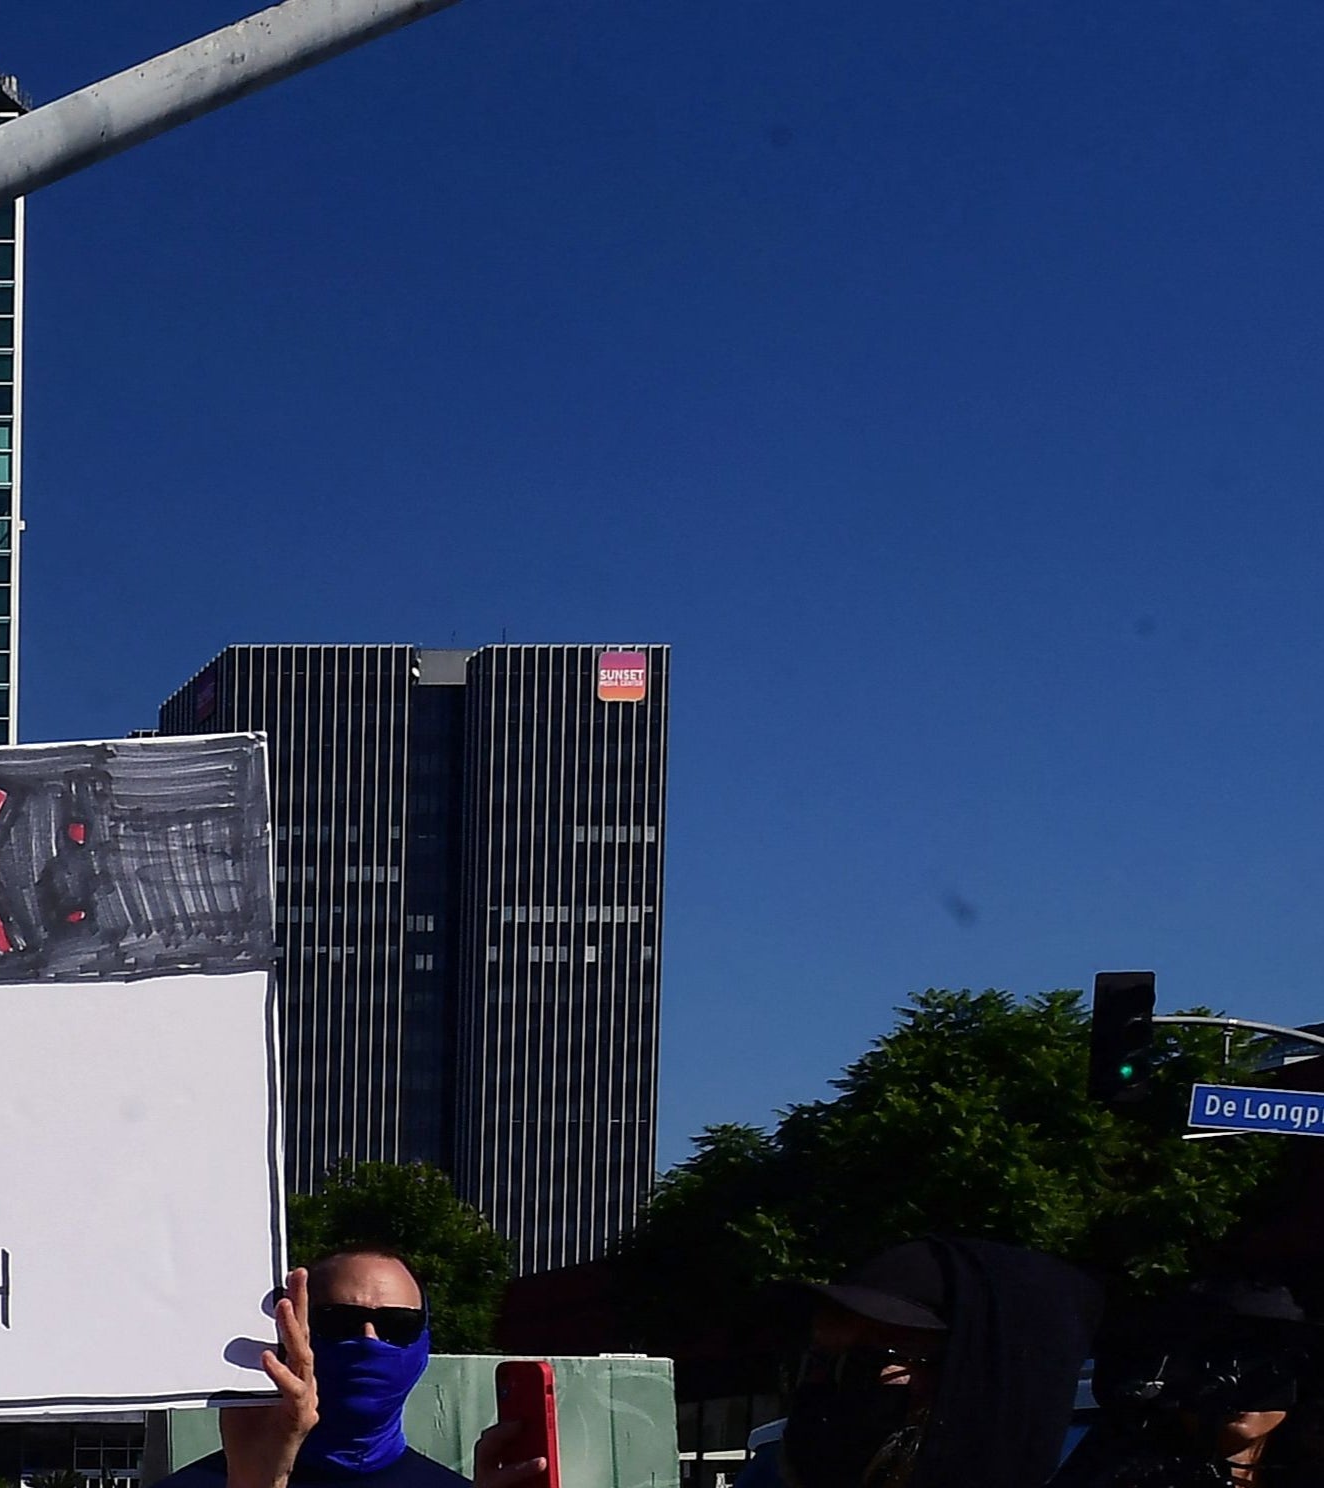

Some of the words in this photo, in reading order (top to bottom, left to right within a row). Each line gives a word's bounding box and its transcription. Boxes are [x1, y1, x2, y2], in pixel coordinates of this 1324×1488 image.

[600, 669, 644, 680] SUNSET
[1204, 1094, 1237, 1117] De
[1243, 1097, 1324, 1129] Longp
